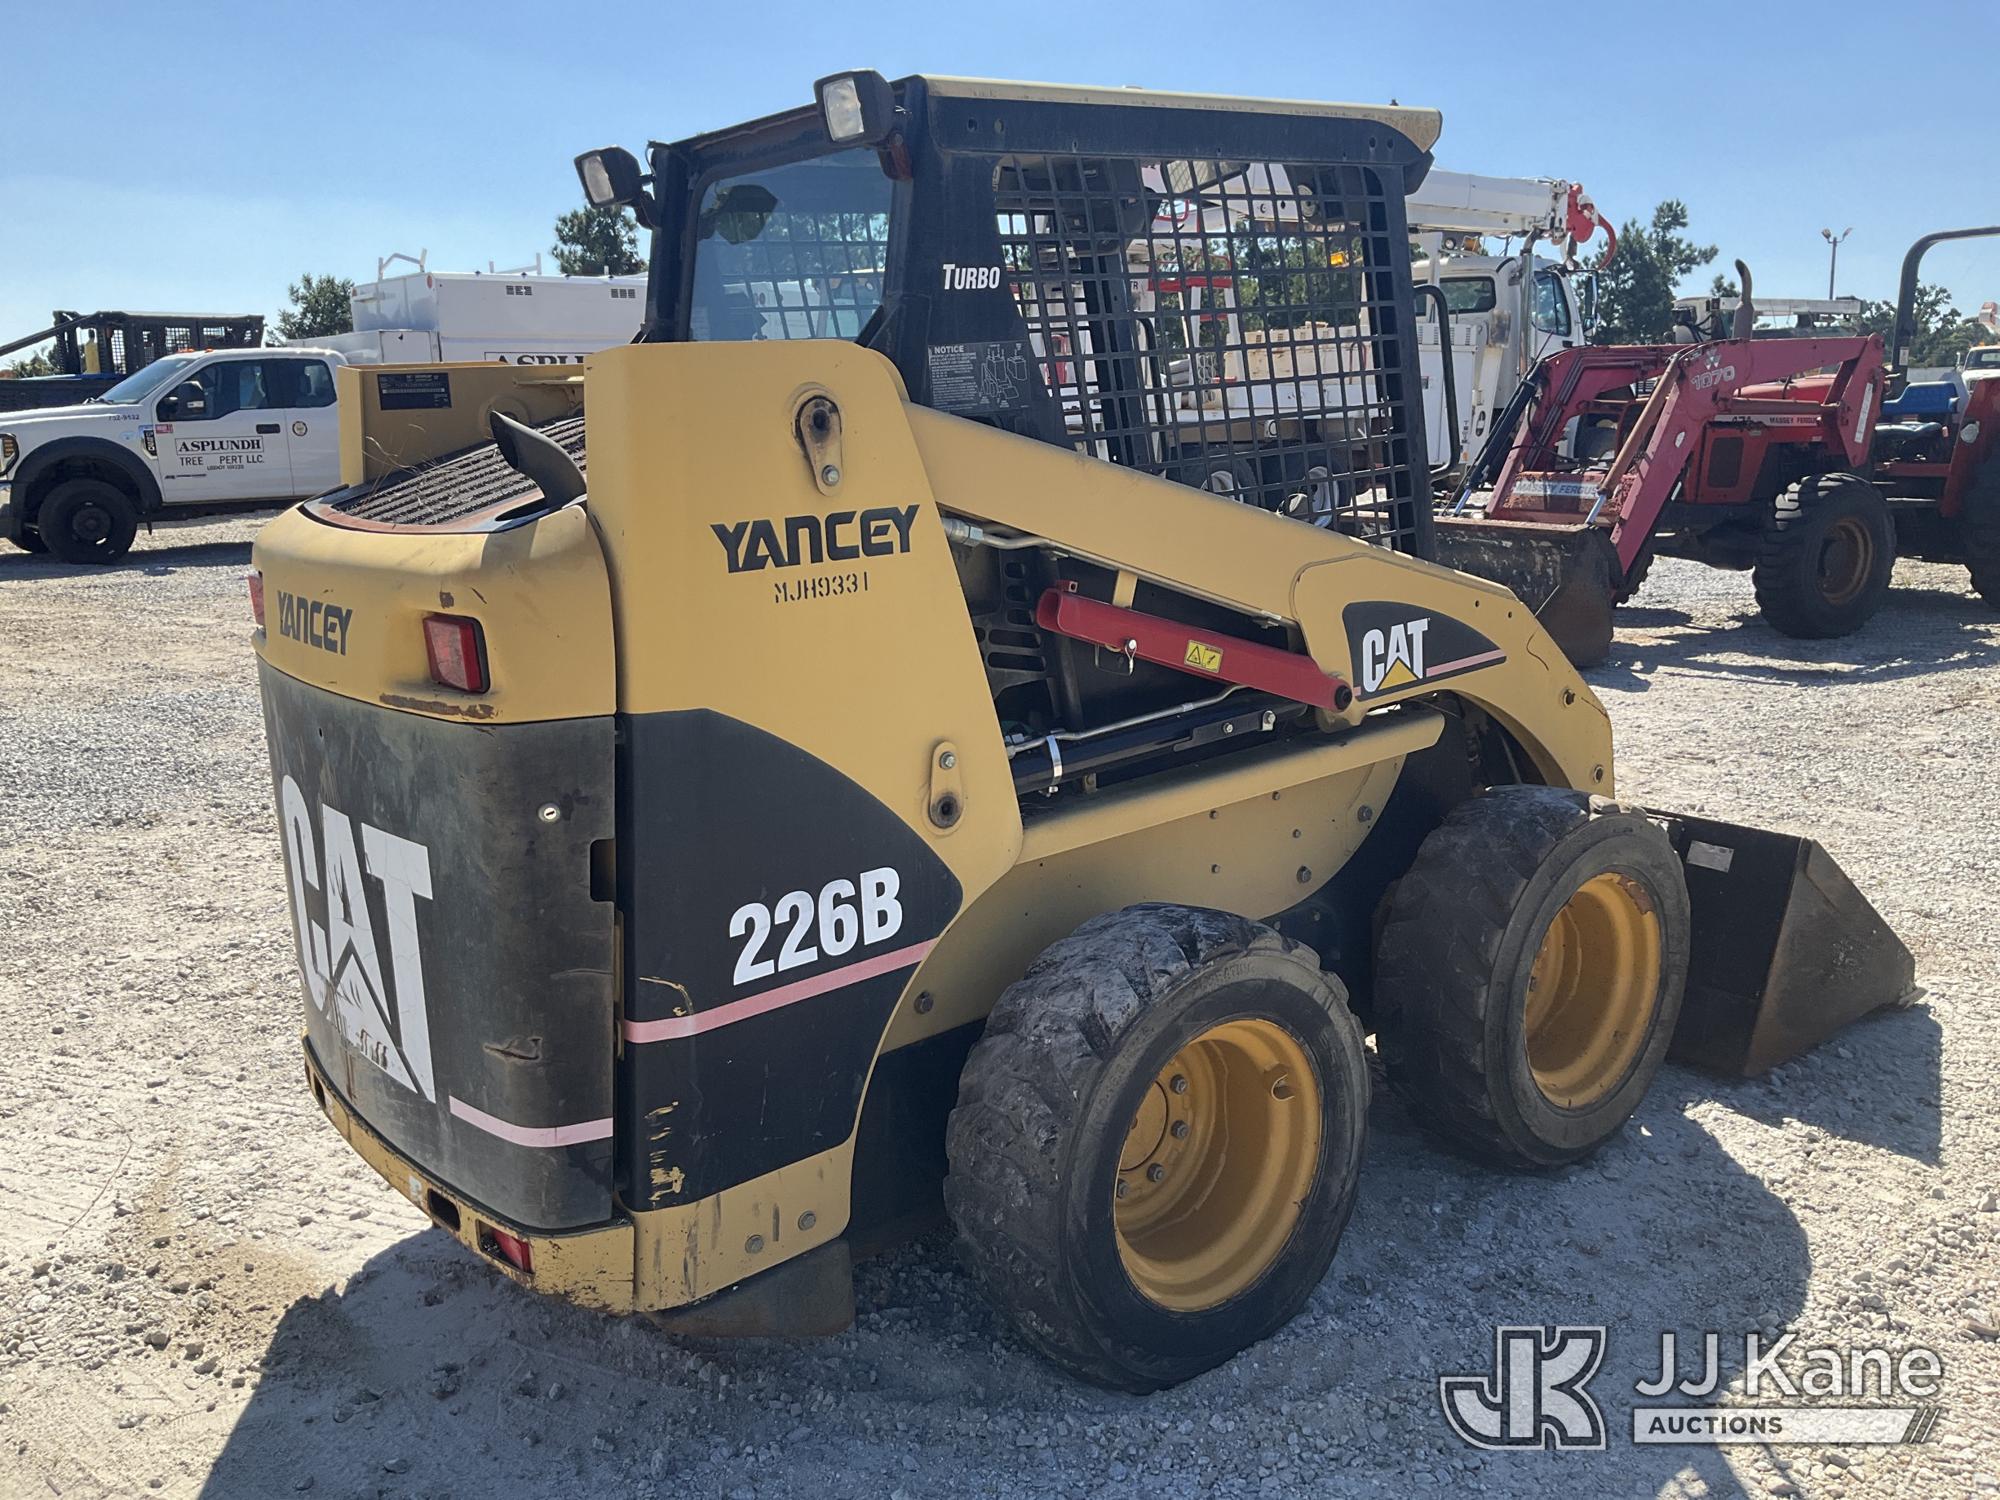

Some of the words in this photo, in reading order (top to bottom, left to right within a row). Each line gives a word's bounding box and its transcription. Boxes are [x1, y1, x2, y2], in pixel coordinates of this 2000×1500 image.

[942, 263, 1001, 290] TURBO
[934, 345, 965, 354] NOTICE
[1691, 365, 1735, 391] 1070
[178, 439, 262, 453] ASPLUNDH
[180, 456, 204, 467] TREE
[709, 503, 921, 574] YANCEY
[276, 589, 354, 656] YANCEY
[1362, 617, 1429, 693] CAT
[282, 774, 434, 1104] CAT
[728, 866, 903, 986] 226B
